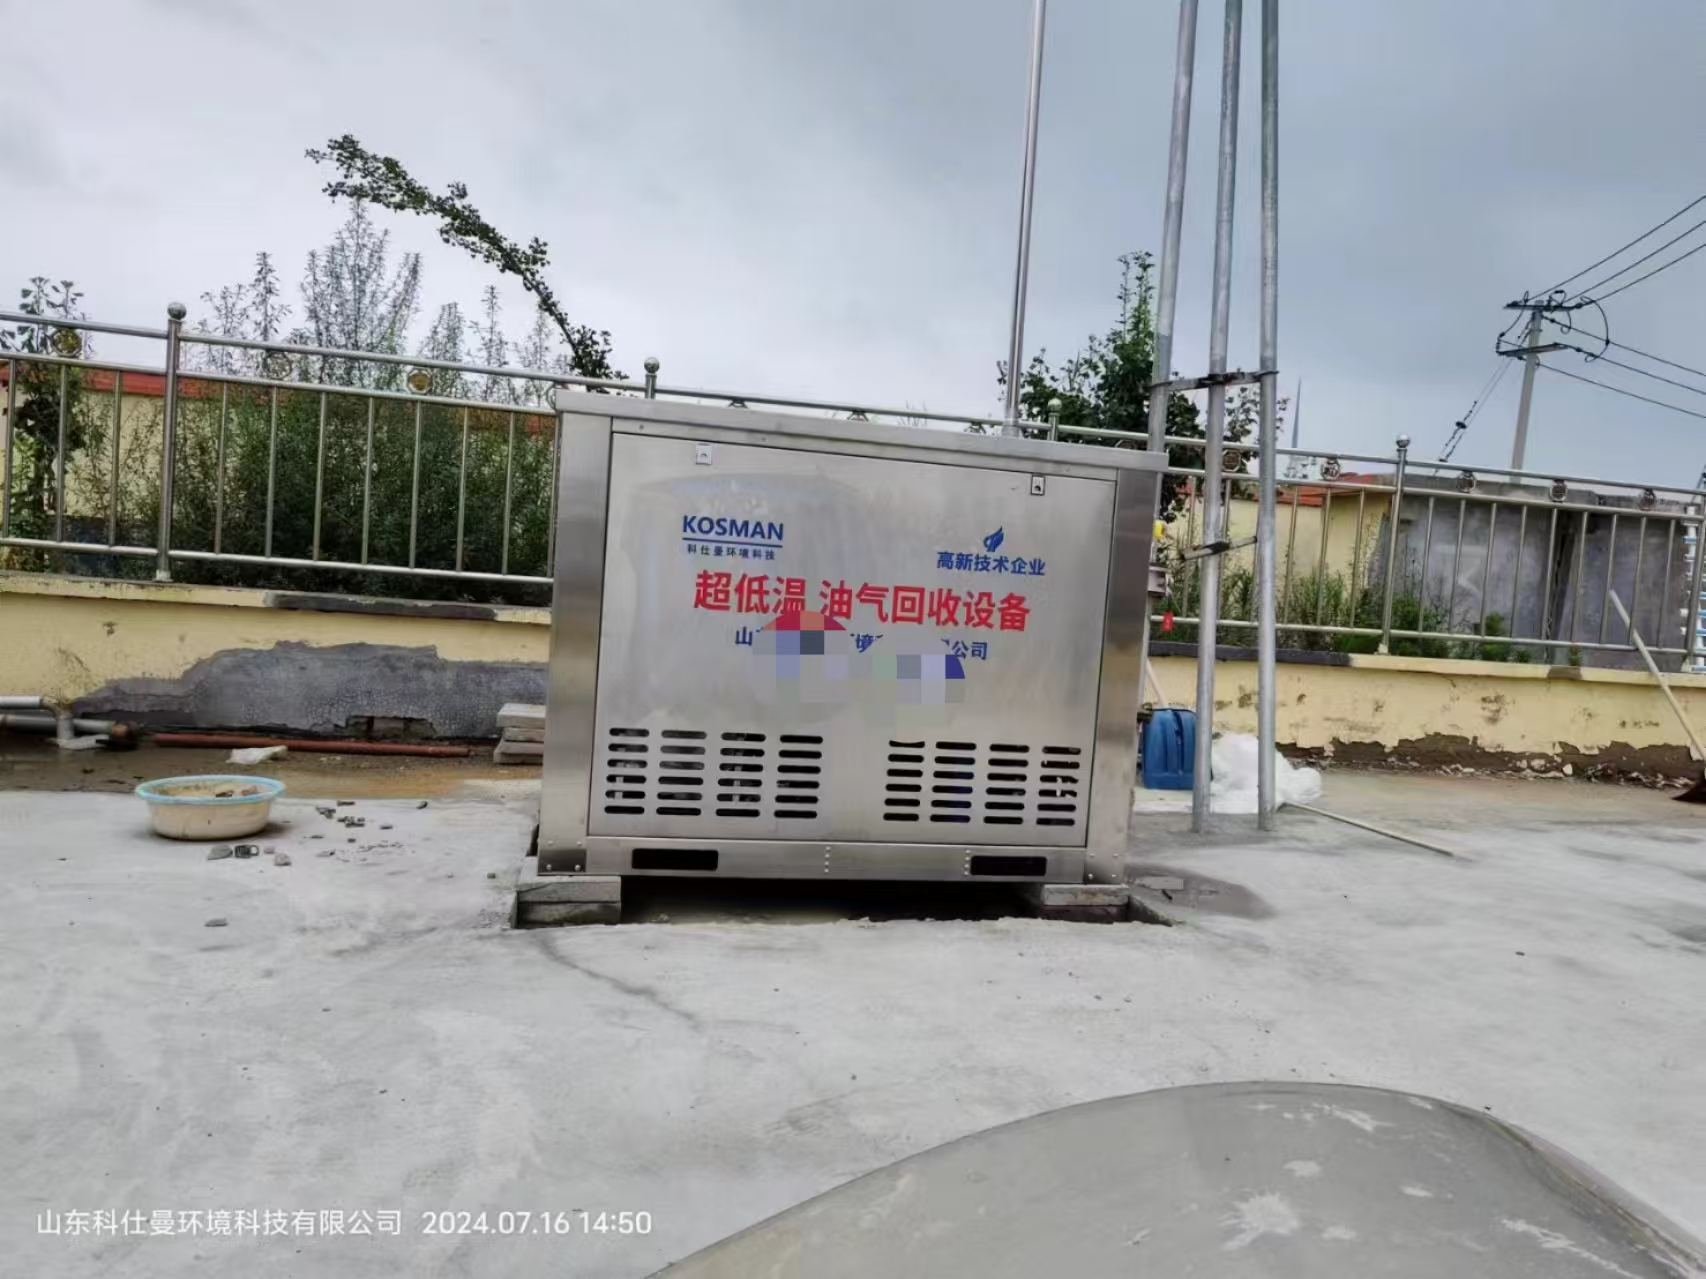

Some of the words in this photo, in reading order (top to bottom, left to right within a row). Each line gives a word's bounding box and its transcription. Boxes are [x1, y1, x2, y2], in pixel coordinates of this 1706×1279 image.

[682, 515, 784, 541] KOSMAN
[687, 543, 776, 561] 科仕曼环境科技
[936, 551, 1046, 577] 高新技术企业
[693, 569, 806, 615] 超低温
[819, 579, 1031, 632] 油气回收设备
